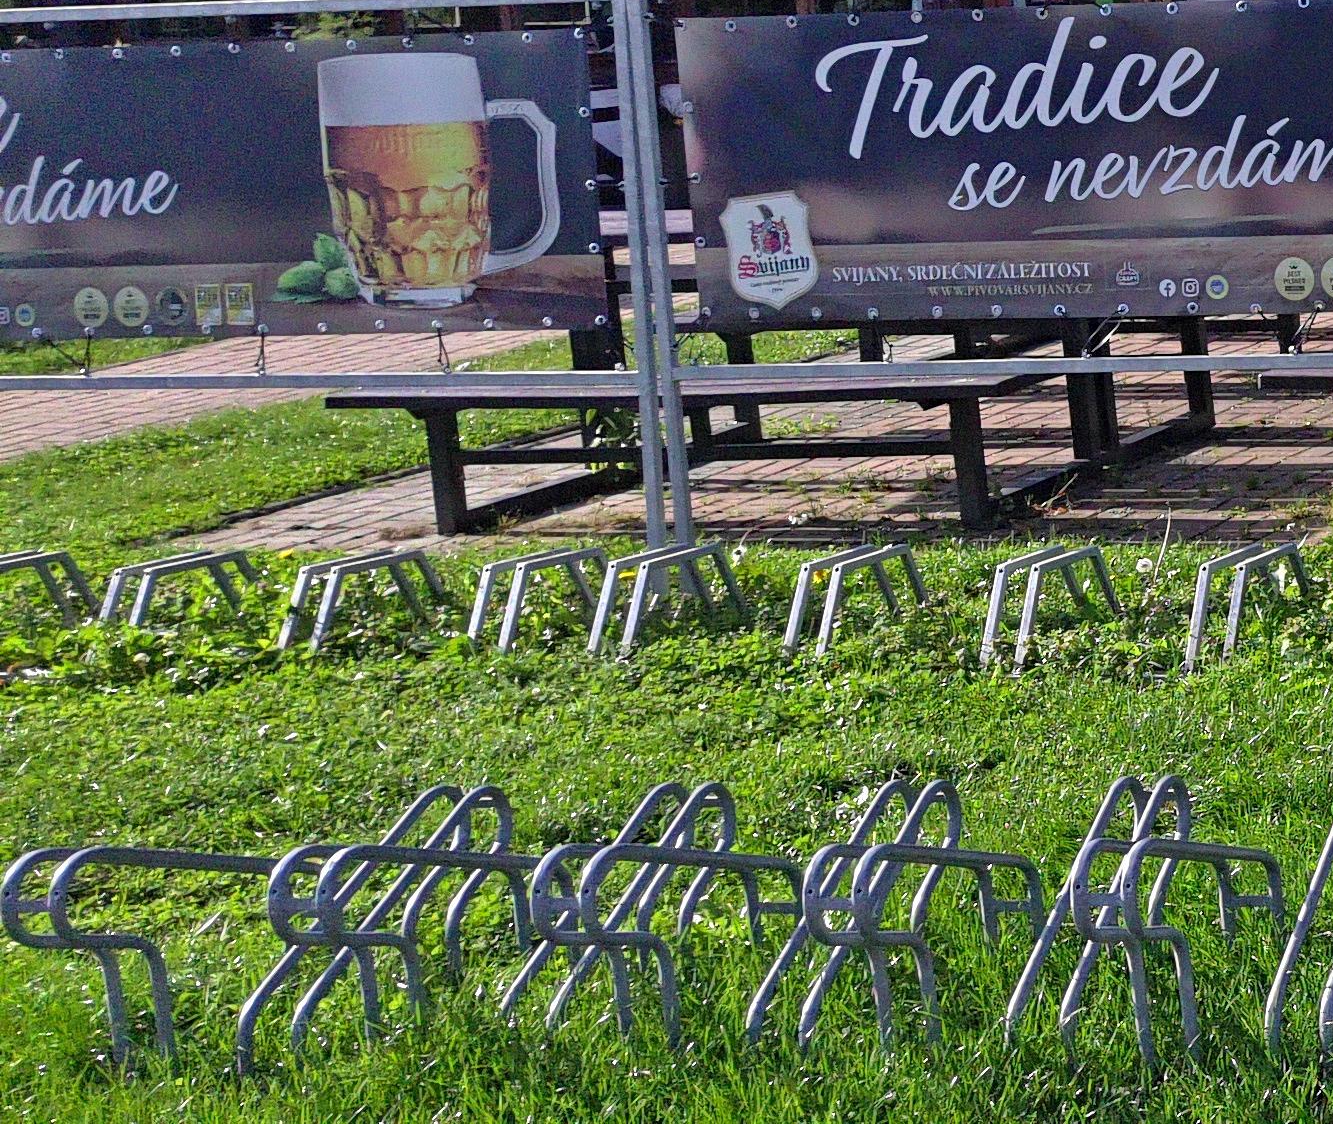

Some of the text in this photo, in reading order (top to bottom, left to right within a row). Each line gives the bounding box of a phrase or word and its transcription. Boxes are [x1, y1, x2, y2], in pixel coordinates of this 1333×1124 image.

[814, 16, 1220, 160] Tradice
[0, 155, 179, 225] dáme
[948, 161, 1026, 211] se
[738, 255, 810, 279] Svijany
[832, 265, 902, 286] SVIJANY,
